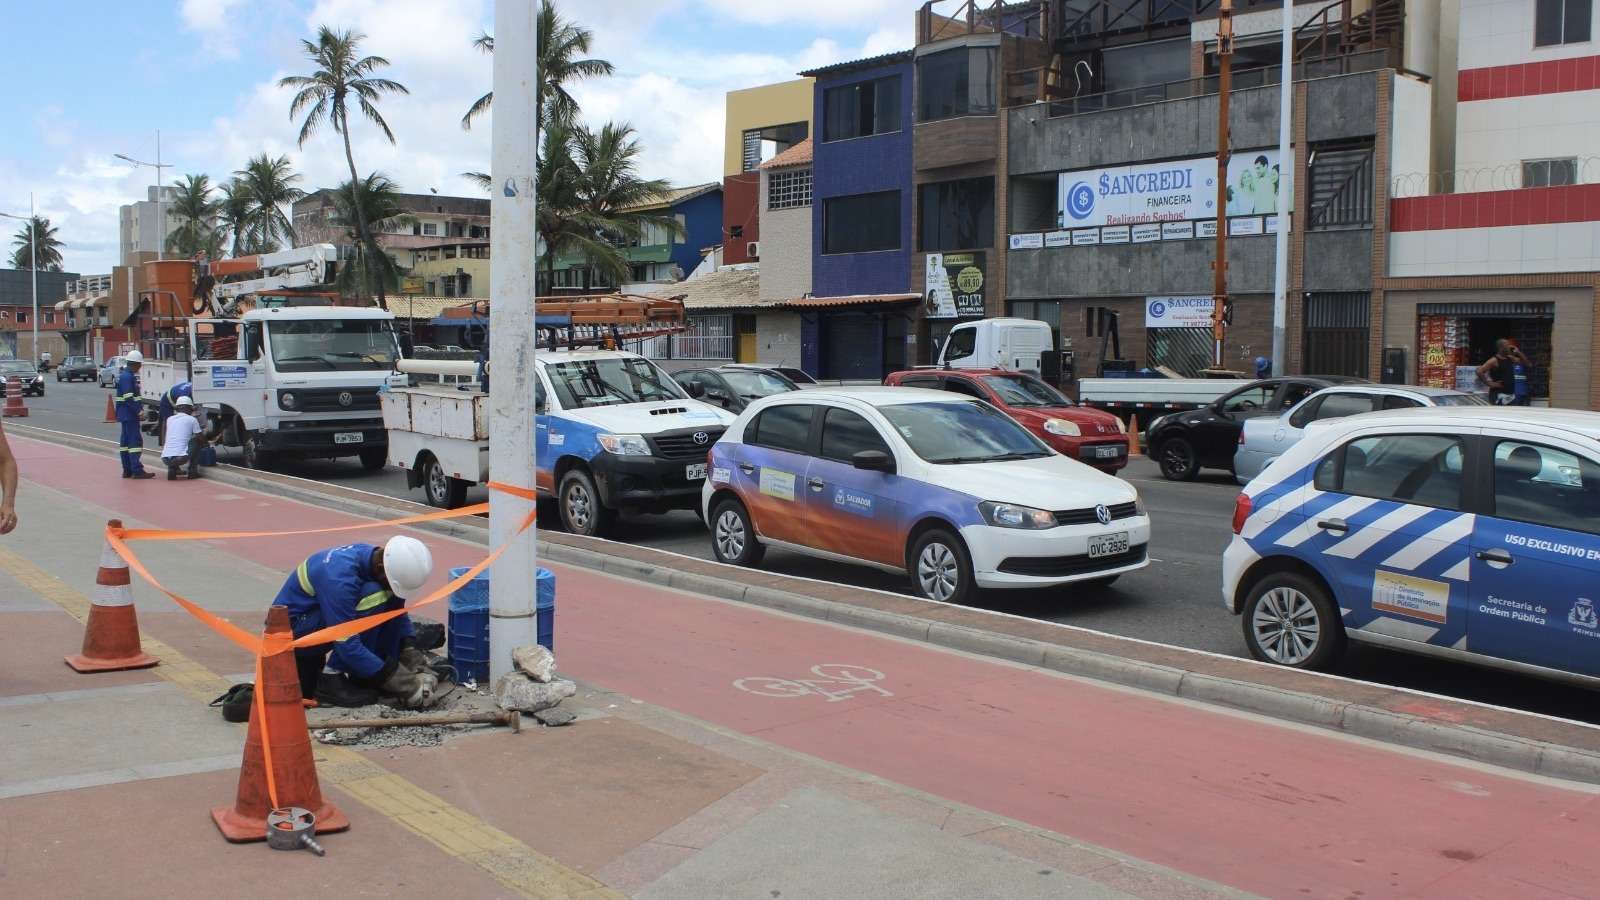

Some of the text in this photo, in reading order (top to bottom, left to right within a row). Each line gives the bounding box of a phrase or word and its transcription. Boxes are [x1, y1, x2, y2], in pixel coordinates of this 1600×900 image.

[1147, 194, 1192, 207] FINANCEIRA
[1106, 213, 1150, 225] Realizando
[847, 494, 871, 508] SALVADOR
[1504, 533, 1526, 546] USO
[1526, 538, 1585, 558] EXCLUSIVO
[1487, 595, 1548, 614] Secretaria de
[1479, 605, 1546, 625] Ordem Pública
